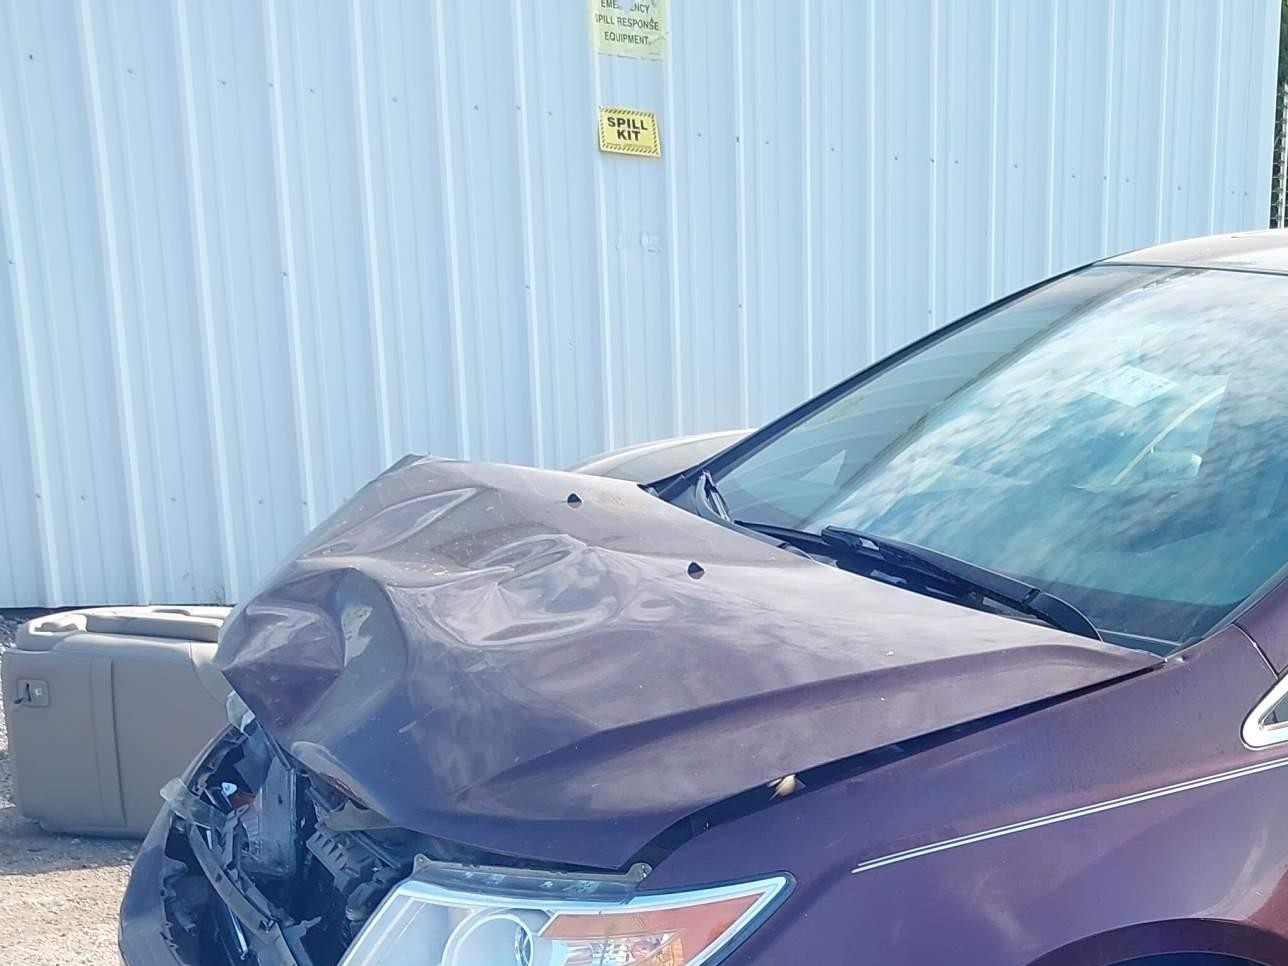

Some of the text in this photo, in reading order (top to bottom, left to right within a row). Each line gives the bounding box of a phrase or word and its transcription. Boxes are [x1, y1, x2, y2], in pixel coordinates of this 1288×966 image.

[600, 0, 650, 14] EMENCY
[617, 16, 660, 31] RESPONSE
[607, 116, 648, 131] SPILL
[617, 129, 641, 141] KIT
